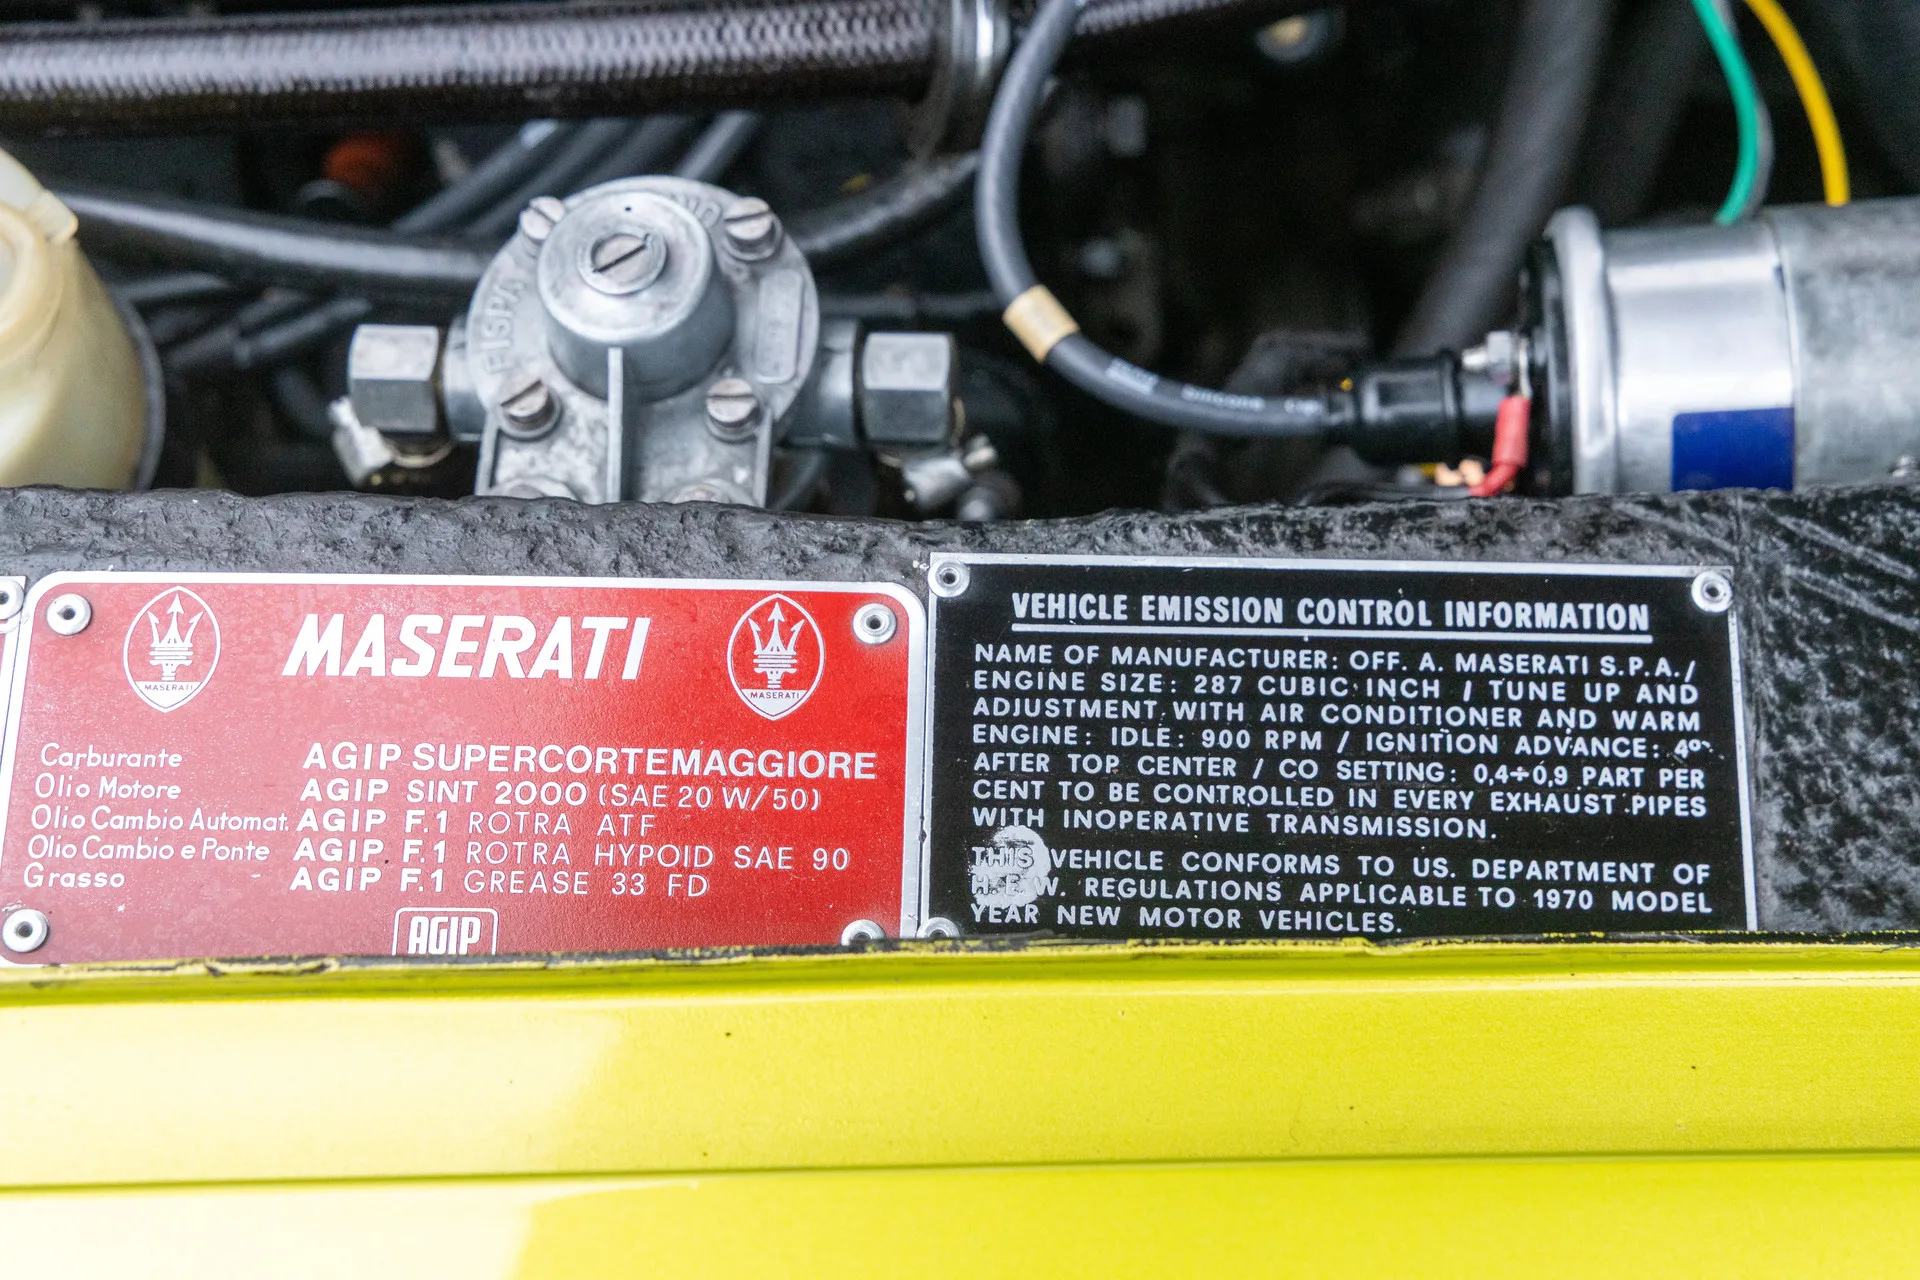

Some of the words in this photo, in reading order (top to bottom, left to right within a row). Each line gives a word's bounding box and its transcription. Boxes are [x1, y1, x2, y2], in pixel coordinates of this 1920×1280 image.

[1012, 593, 1127, 623] VEHICLE
[1142, 595, 1283, 623] EMISSION
[1297, 598, 1432, 626] CONTROL
[1445, 601, 1648, 630] INFORMATION
[281, 614, 650, 679] MASERATI
[975, 644, 1052, 663] NAME
[1064, 645, 1099, 664] OF
[1112, 646, 1337, 669] MANUFACTURER:
[1350, 650, 1407, 671] OFF.
[1419, 652, 1443, 671] A.
[1456, 653, 1588, 675] MASERATI
[750, 691, 800, 699] MASERATI
[975, 670, 1085, 691] ENGINE
[1194, 675, 1241, 694] 287
[1258, 675, 1348, 696] CUBIC
[1367, 678, 1439, 701] INCH
[1489, 678, 1565, 701] TUNE
[1585, 683, 1620, 702] UP
[1636, 684, 1698, 704] AND
[973, 697, 1157, 719] ADJUSTMENT
[1173, 701, 1243, 721] WITH
[1260, 703, 1303, 723] AIR
[1321, 704, 1522, 727] CONDITIONER
[1537, 708, 1596, 729] AND
[1612, 710, 1700, 731] WARM
[41, 743, 182, 770] Carburante
[1202, 729, 1250, 748] 900
[1266, 730, 1321, 750] RPM
[1367, 732, 1497, 754] IGNITION
[303, 742, 401, 770] AGIP
[412, 742, 876, 779] SUPERCORTEMAGGIORE
[974, 752, 1049, 772] AFTER
[1068, 754, 1119, 774] TOP
[1138, 756, 1236, 777] CENTER
[1279, 759, 1318, 779] CO
[1583, 766, 1644, 787] PART
[1660, 768, 1704, 789] PER
[35, 772, 90, 798] Olio
[99, 776, 181, 799] Motore
[300, 778, 388, 802] AGIP
[407, 779, 478, 803] SINT
[495, 781, 586, 806] 2000
[599, 783, 667, 807] (SAE
[678, 786, 711, 808] 20
[973, 779, 1044, 799] CENT
[1058, 781, 1094, 801] TO
[1109, 782, 1139, 802] BE
[1154, 783, 1334, 807] CONTROLLED
[1349, 788, 1376, 807] IN
[1394, 789, 1474, 810] EVERY
[1491, 792, 1616, 814] EXHAUST
[1632, 795, 1706, 817] PIPES
[31, 804, 85, 829] Olio
[91, 805, 183, 830] Cambio
[189, 808, 288, 831] Automat.
[296, 808, 386, 832] AGIP
[406, 810, 447, 833] F.1
[469, 811, 570, 835] ROTRA
[597, 814, 655, 836] ATF
[973, 807, 1044, 827] WITH
[1064, 809, 1248, 832] INOPERATIVE
[1267, 814, 1496, 838] TRANSMISSION.
[28, 834, 77, 859] Olio
[83, 835, 174, 859] Cambio
[181, 845, 196, 859] e
[202, 838, 270, 860] Ponte
[293, 838, 383, 862] AGIP
[403, 839, 445, 863] F.1
[467, 841, 570, 864] ROTRA
[595, 844, 713, 867] HYPOID
[734, 846, 793, 869] SAE
[813, 848, 848, 870] 90
[24, 862, 124, 888] Grasso
[971, 846, 1034, 868] THIS
[1051, 849, 1163, 870] VEHICLE
[1182, 852, 1340, 875] CONFORMS
[1358, 856, 1394, 876] TO
[1413, 857, 1455, 878] US.
[1472, 859, 1655, 883] DEPARTMENT
[1673, 864, 1710, 884] OF
[290, 867, 381, 891] AGIP
[400, 868, 443, 892] F.1
[464, 870, 588, 894] GREASE
[612, 873, 644, 895] 33
[668, 874, 707, 896] FD
[1085, 877, 1281, 901] REGULATIONS
[1300, 883, 1466, 906] APPLICABLE
[1478, 887, 1515, 907] TO
[1534, 889, 1593, 909] 1970
[1612, 890, 1712, 913] MODEL
[970, 903, 1039, 924] YEAR
[1058, 905, 1120, 925] NEW
[1140, 907, 1240, 928] MOTOR
[1259, 910, 1401, 933] VEHICLES.
[408, 915, 481, 955] AGIP
